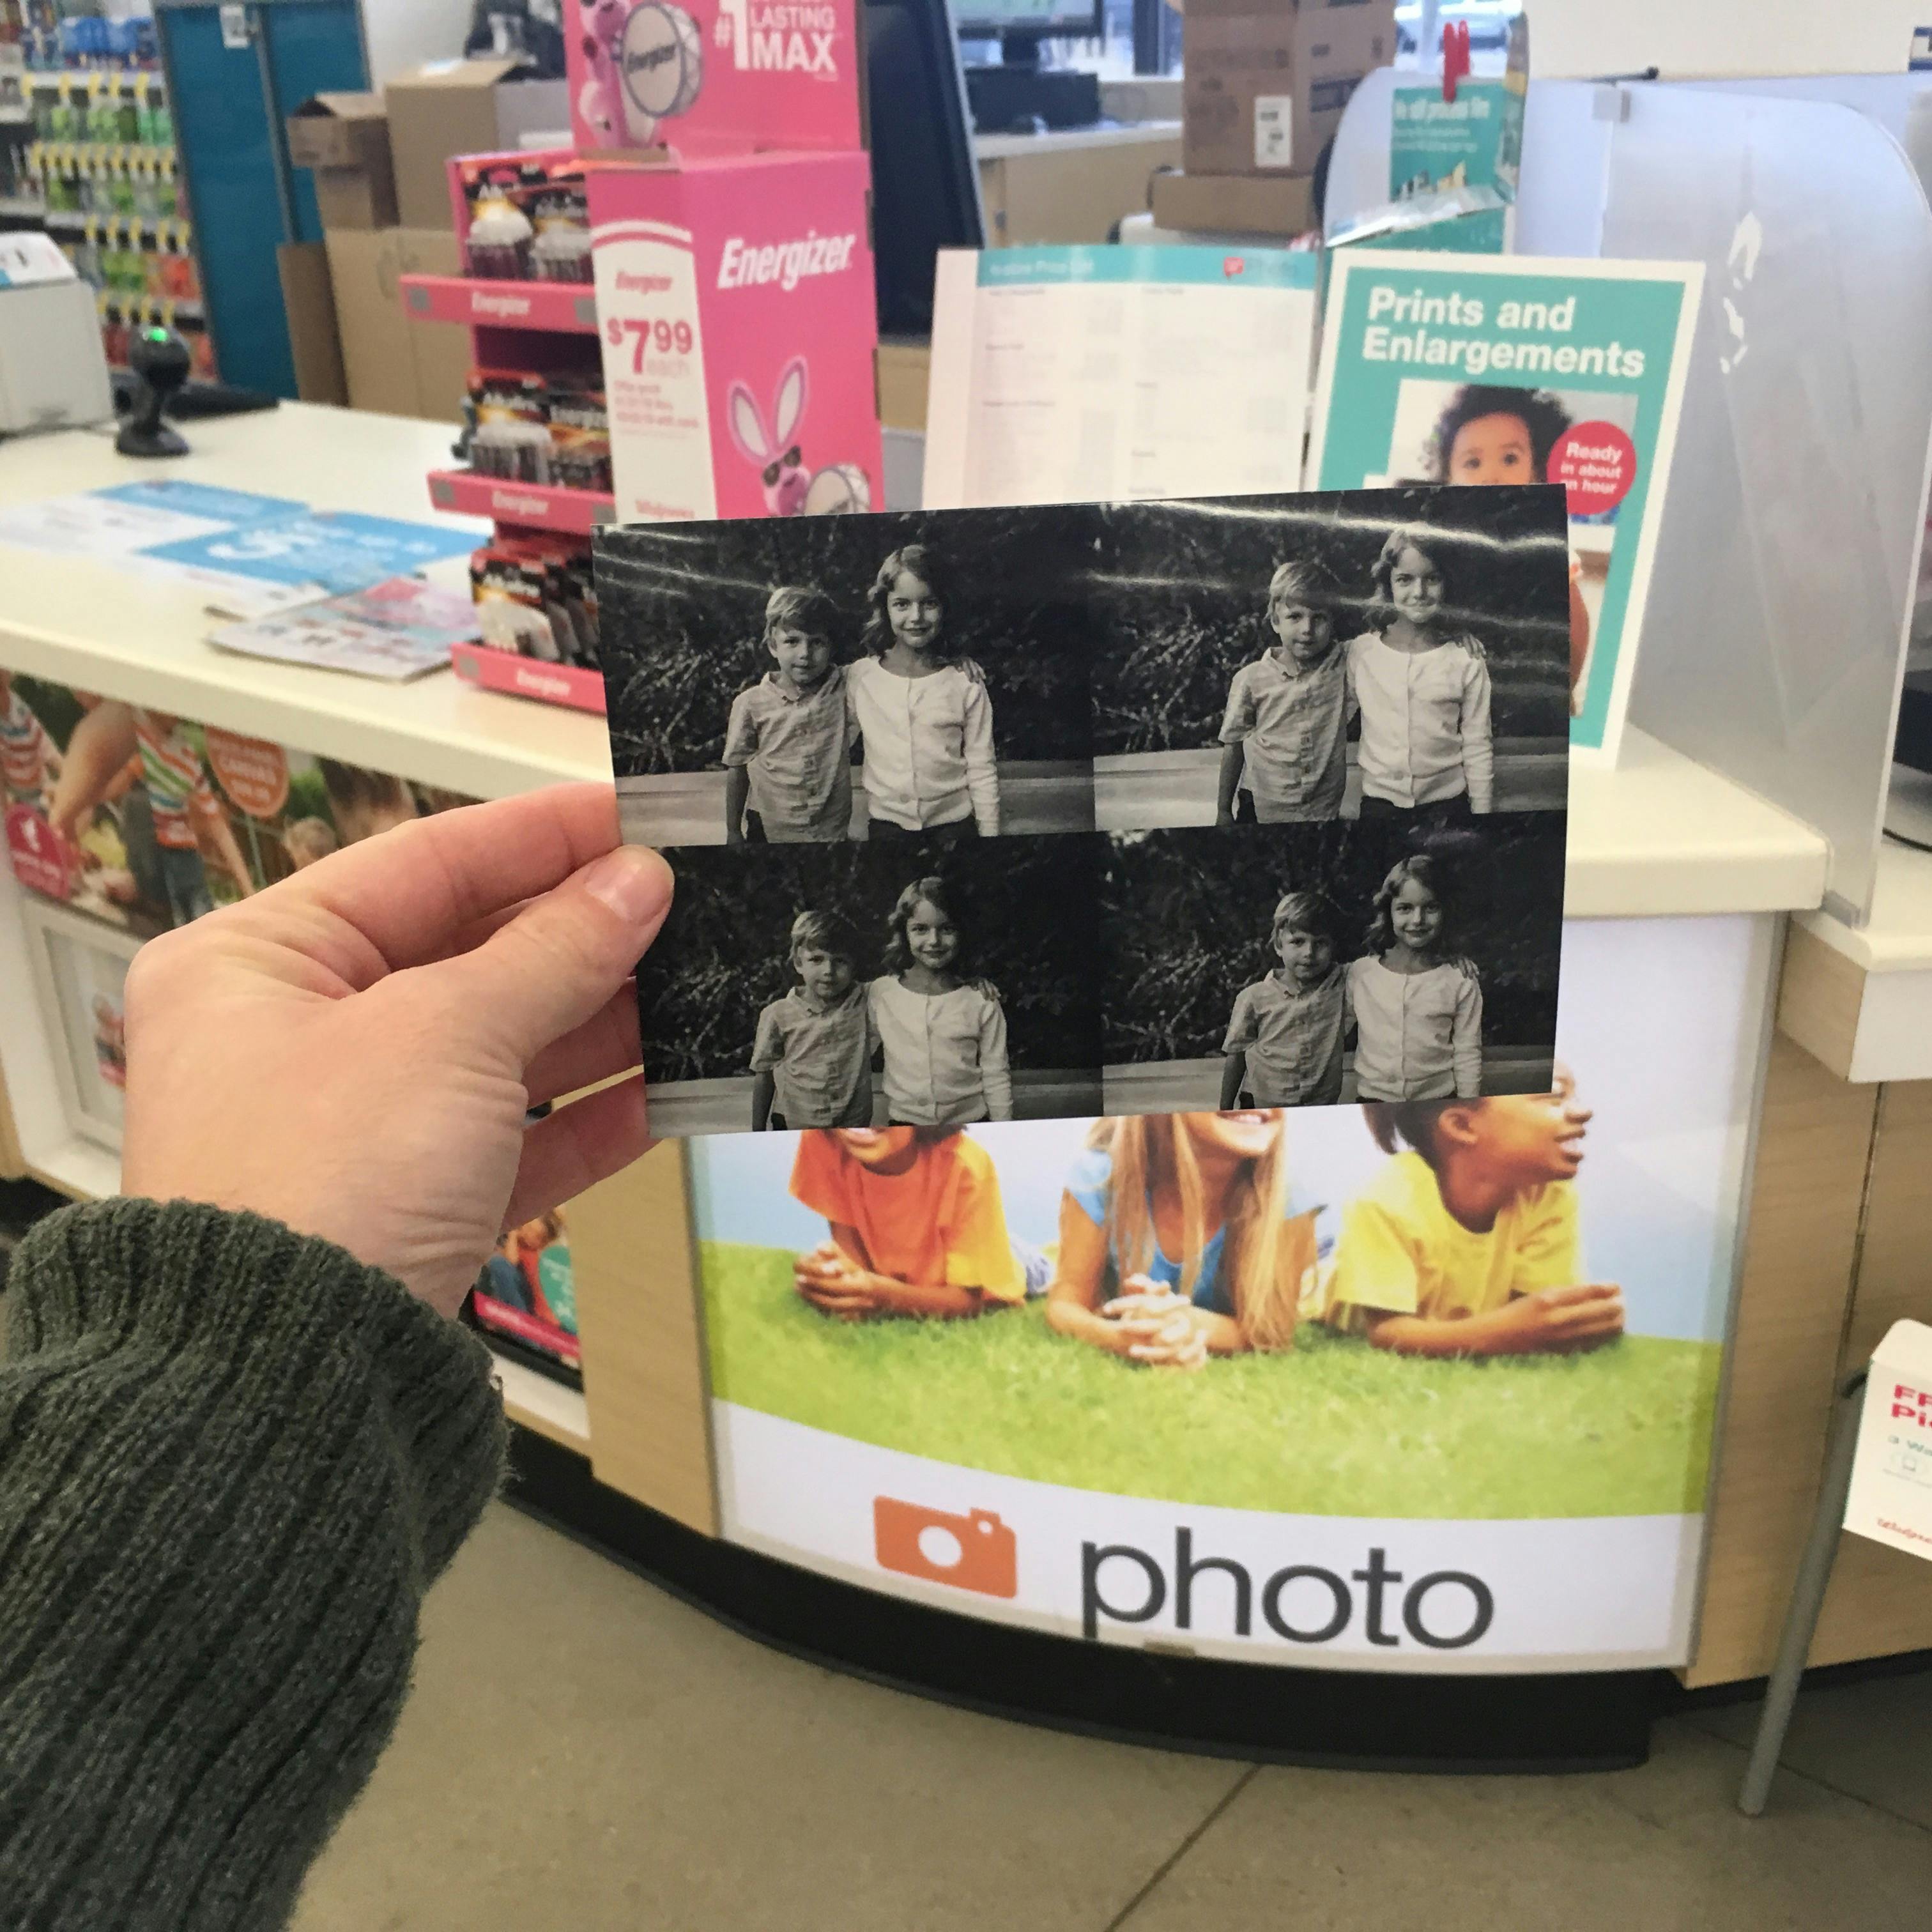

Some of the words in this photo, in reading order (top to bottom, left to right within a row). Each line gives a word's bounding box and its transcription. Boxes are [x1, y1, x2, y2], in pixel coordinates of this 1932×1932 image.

[750, 5, 835, 30] LASTING
[752, 31, 836, 72] MAX
[716, 228, 857, 291] Energizer
[1368, 286, 1484, 328] Prints
[1496, 295, 1576, 332] and
[1361, 325, 1646, 378] Enlargements
[1566, 441, 1623, 465] Ready
[1560, 461, 1574, 475] in
[1577, 463, 1621, 480] about
[1581, 479, 1617, 494] hour
[1891, 1403, 1932, 1427] Pi
[1081, 1526, 1494, 1649] photo
